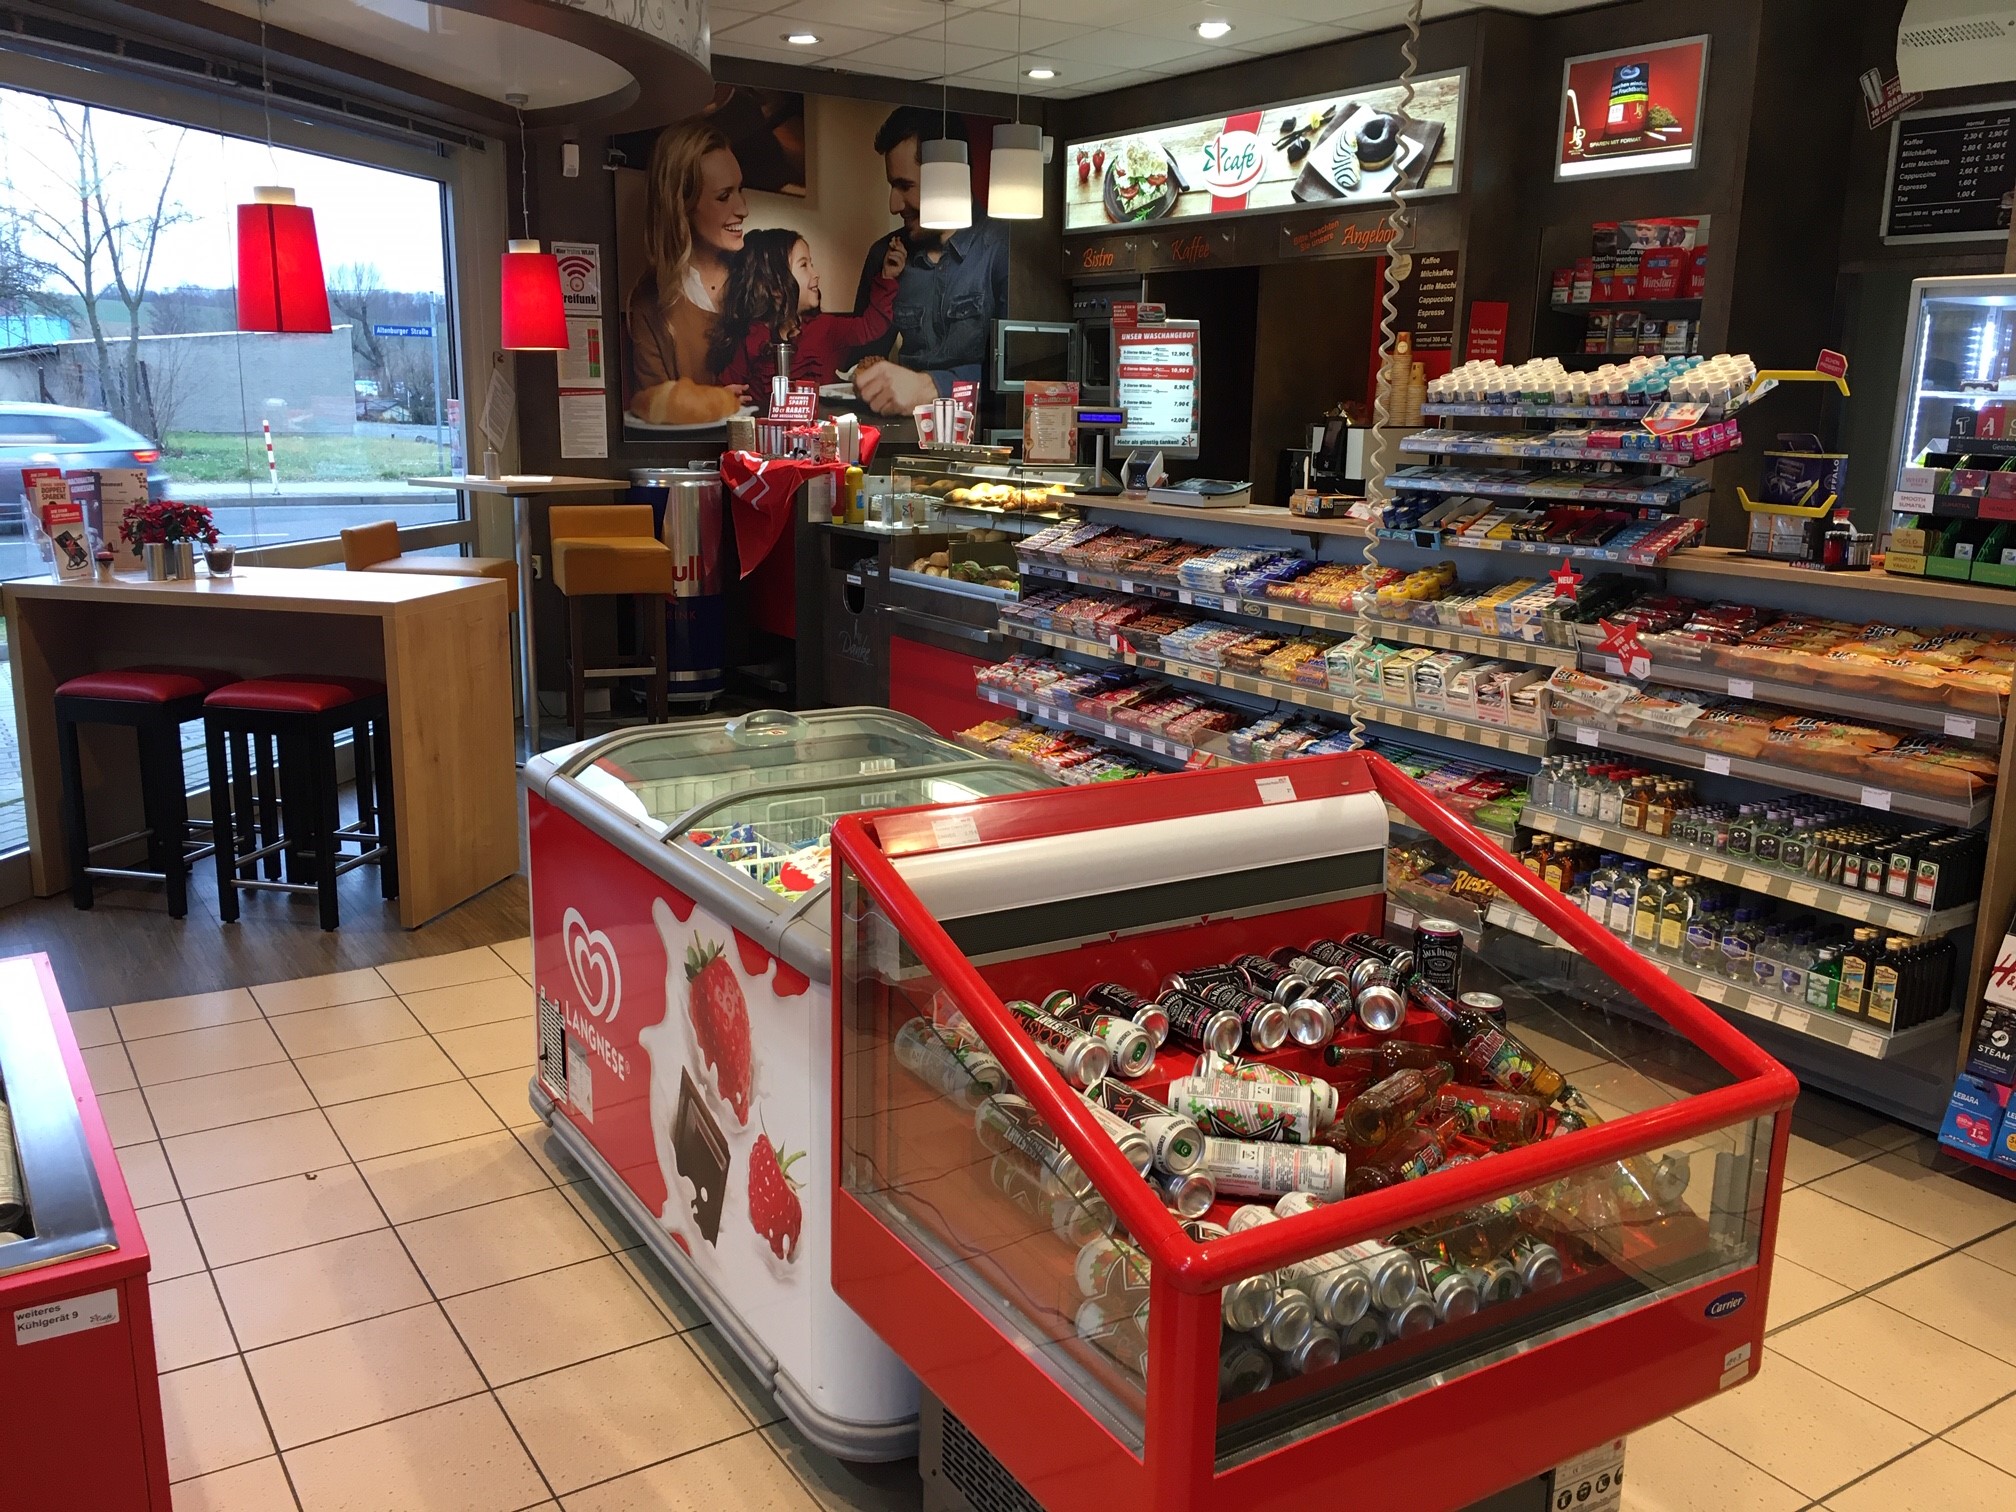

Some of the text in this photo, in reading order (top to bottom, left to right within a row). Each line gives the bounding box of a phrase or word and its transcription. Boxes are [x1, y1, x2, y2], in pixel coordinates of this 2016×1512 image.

[1871, 108, 1879, 118] 10
[1902, 149, 1937, 157] Milchkaffee
[1223, 143, 1256, 180] café
[1918, 159, 1949, 167] Macchiato
[1900, 171, 1936, 180] Cappuccino
[1898, 183, 1927, 191] Espresso
[1897, 195, 1908, 203] Tee
[1309, 220, 1340, 240] beachten
[1341, 218, 1397, 251] Angebo
[1311, 232, 1334, 247] unsere
[1171, 236, 1210, 263] Kaffee
[1083, 247, 1114, 268] Bistro
[1421, 256, 1441, 265] Kaffee
[1420, 268, 1454, 278] Milchkaffee
[1435, 281, 1457, 290] Macchi
[1643, 276, 1672, 288] Winston
[1692, 275, 1705, 286] Win
[562, 293, 597, 305] reifunk
[1418, 295, 1453, 305] Cappuccino
[1417, 309, 1445, 317] Espresso
[376, 326, 429, 336] Altenburger Straße
[1417, 322, 1427, 330] Tee
[1831, 459, 1840, 494] FFALO
[41, 486, 66, 494] DOPPELT
[41, 492, 66, 501] SPAREN!
[1901, 495, 1926, 503] SMOOTH
[1897, 537, 1918, 545] GOLD
[672, 556, 702, 582] ull
[1558, 576, 1573, 585] NEU!
[667, 610, 697, 621] RINK
[1422, 948, 1436, 959] JACK
[565, 1000, 625, 1082] LANGNESE
[1977, 1044, 2011, 1062] STEAM
[1953, 1090, 1979, 1106] LEBARA
[1711, 1296, 1743, 1315] Carrier
[16, 1304, 61, 1321] weiteres
[17, 1310, 79, 1332] Kühlgerät 9
